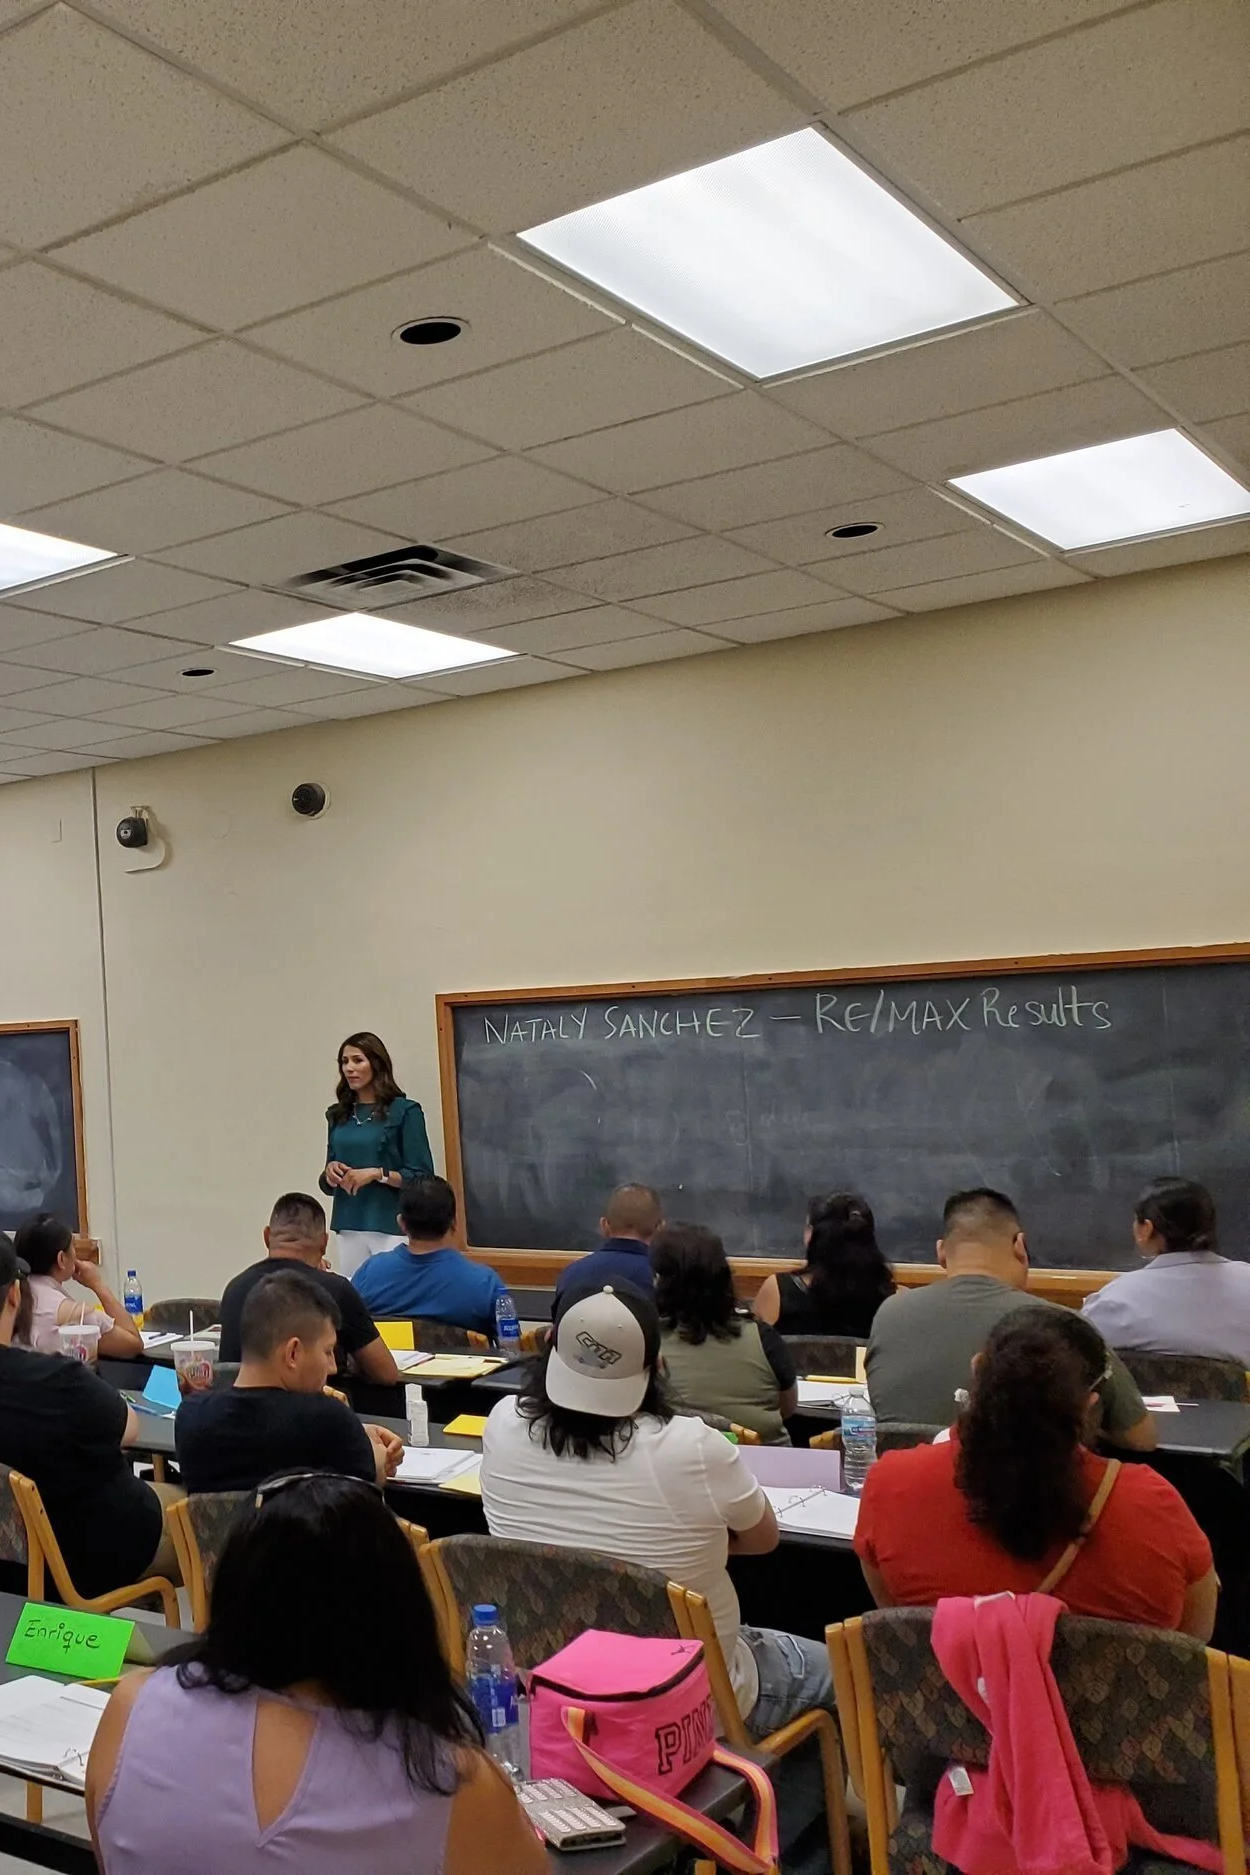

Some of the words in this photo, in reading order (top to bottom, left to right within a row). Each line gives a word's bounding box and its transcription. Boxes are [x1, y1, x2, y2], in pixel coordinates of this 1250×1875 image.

[484, 1007, 588, 1044] NATALY
[604, 1005, 760, 1039] SANCHEZ
[815, 988, 971, 1034] RE/MAX
[981, 985, 1112, 1030] Results
[24, 1619, 102, 1654] Enrique
